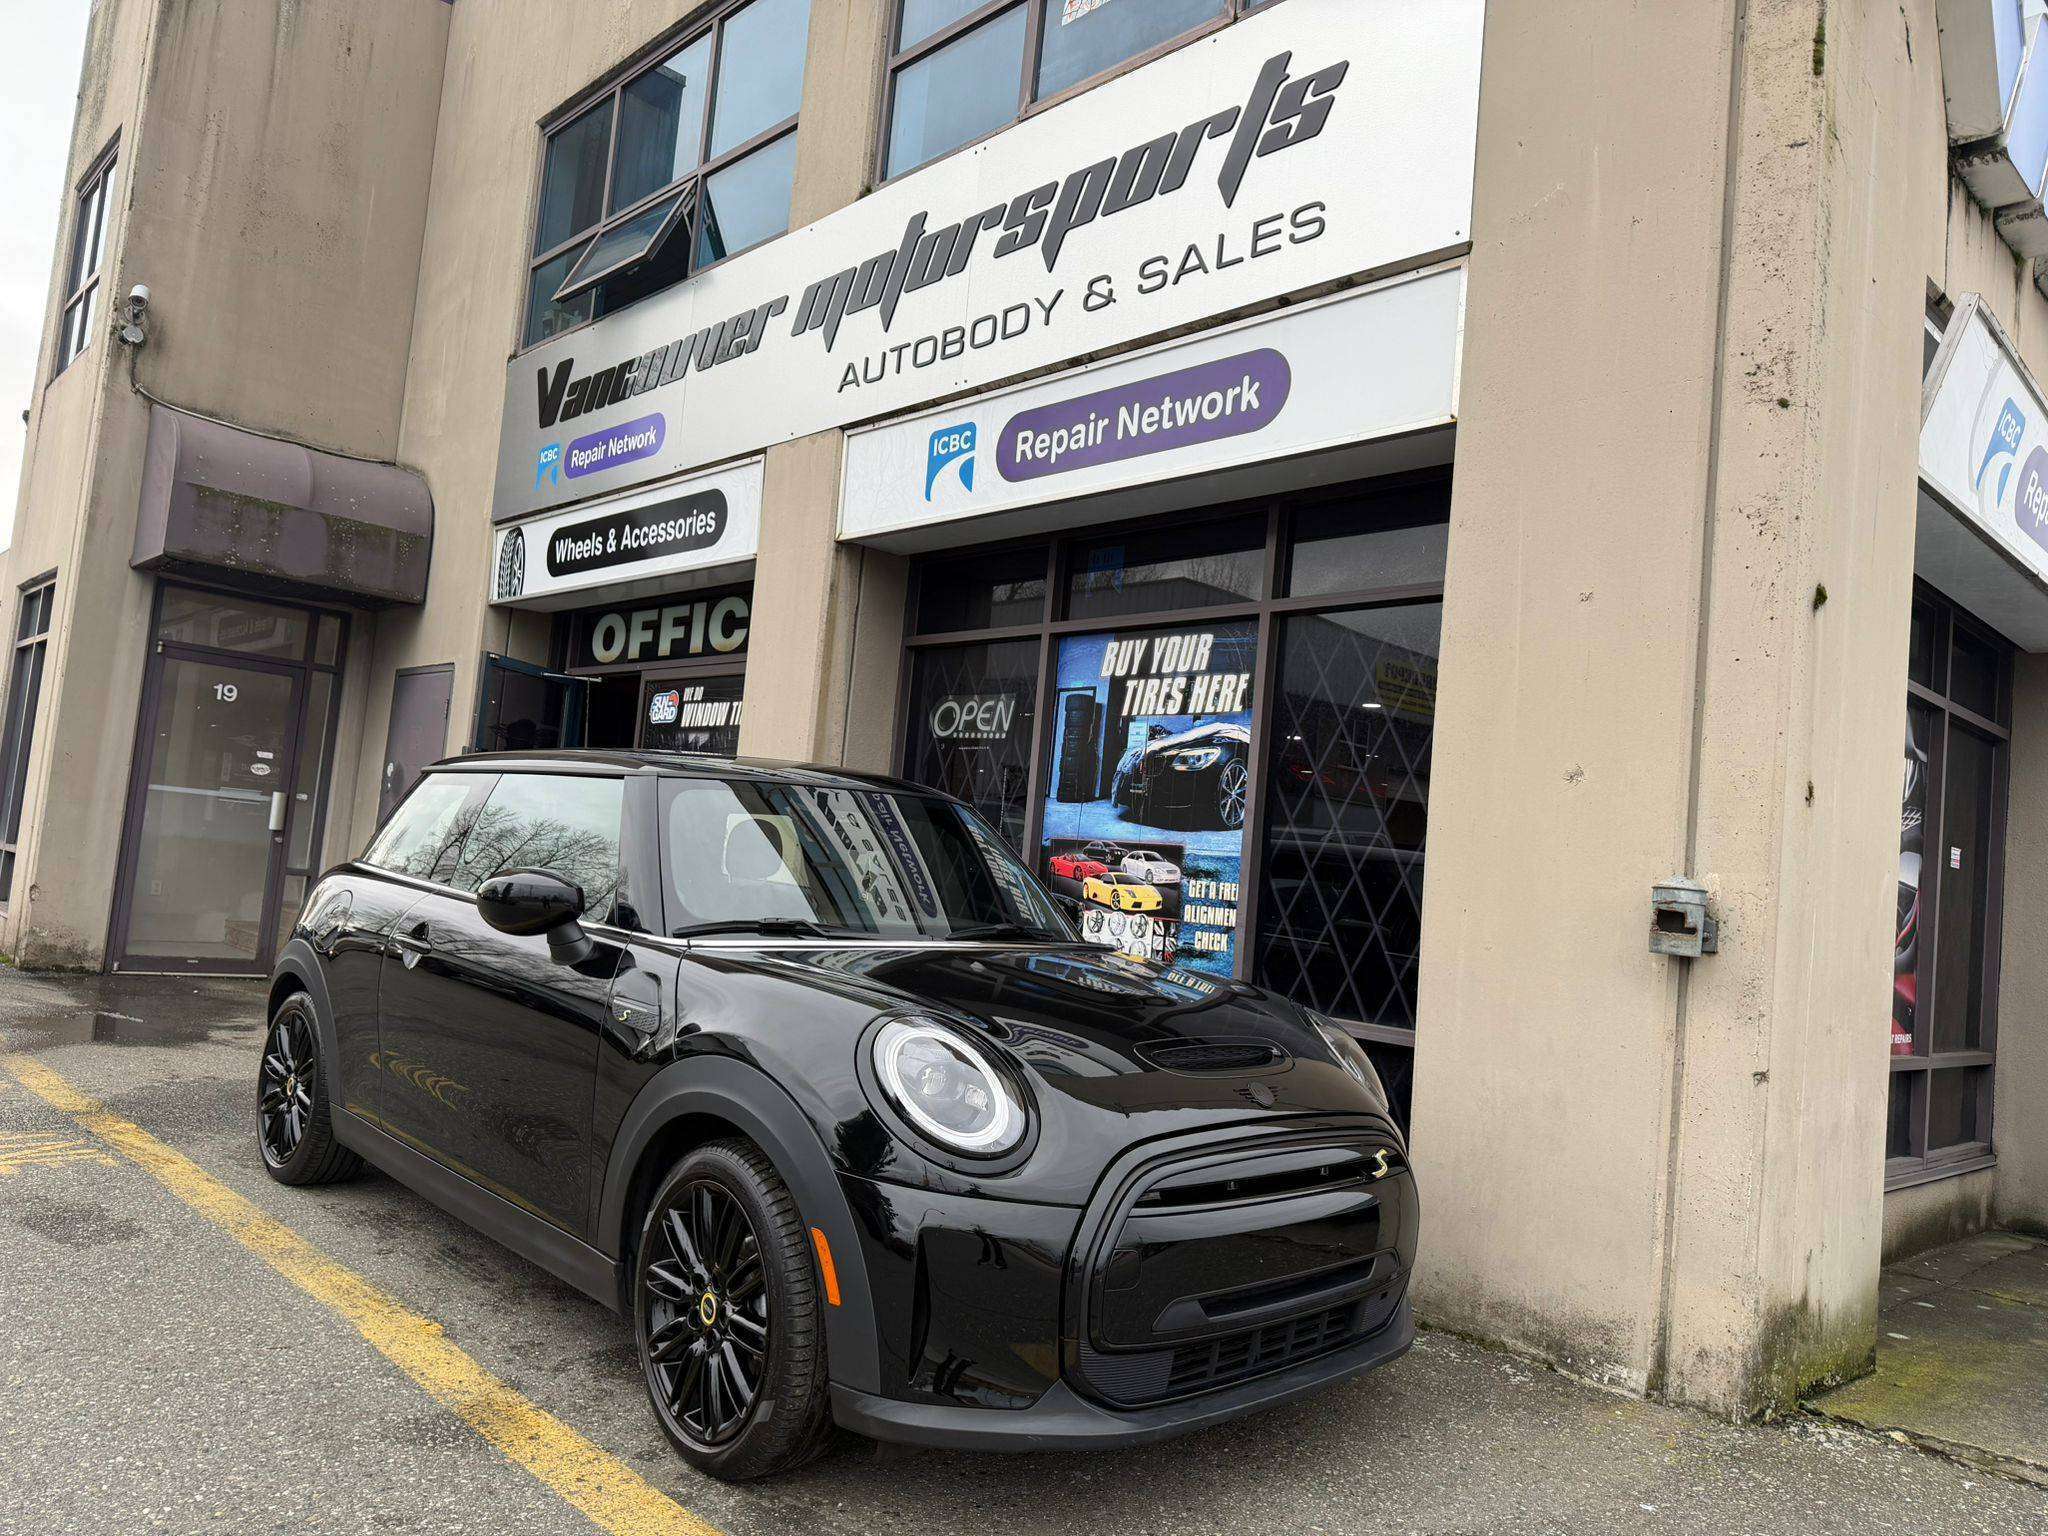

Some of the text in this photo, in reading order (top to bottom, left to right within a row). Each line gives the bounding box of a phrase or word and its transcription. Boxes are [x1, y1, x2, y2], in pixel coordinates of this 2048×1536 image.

[838, 200, 1327, 393] AUTOBODY & SALES
[1015, 374, 1261, 464] Repair Network
[1997, 408, 2021, 449] ICBC
[539, 446, 559, 464] ICBC
[570, 424, 658, 470] Repair Network
[932, 429, 972, 457] ICBC
[555, 507, 717, 564] Wheels & Accessories
[592, 596, 749, 663] OFFIC
[1100, 633, 1214, 677] BUY YOUR
[213, 683, 238, 702] 19
[1121, 673, 1250, 717] TIRES HERE
[681, 701, 743, 727] WINDOW TI
[934, 700, 1015, 737] OPEN
[1188, 880, 1206, 899] GET
[1209, 881, 1216, 900] A
[1195, 931, 1228, 952] CHECK
